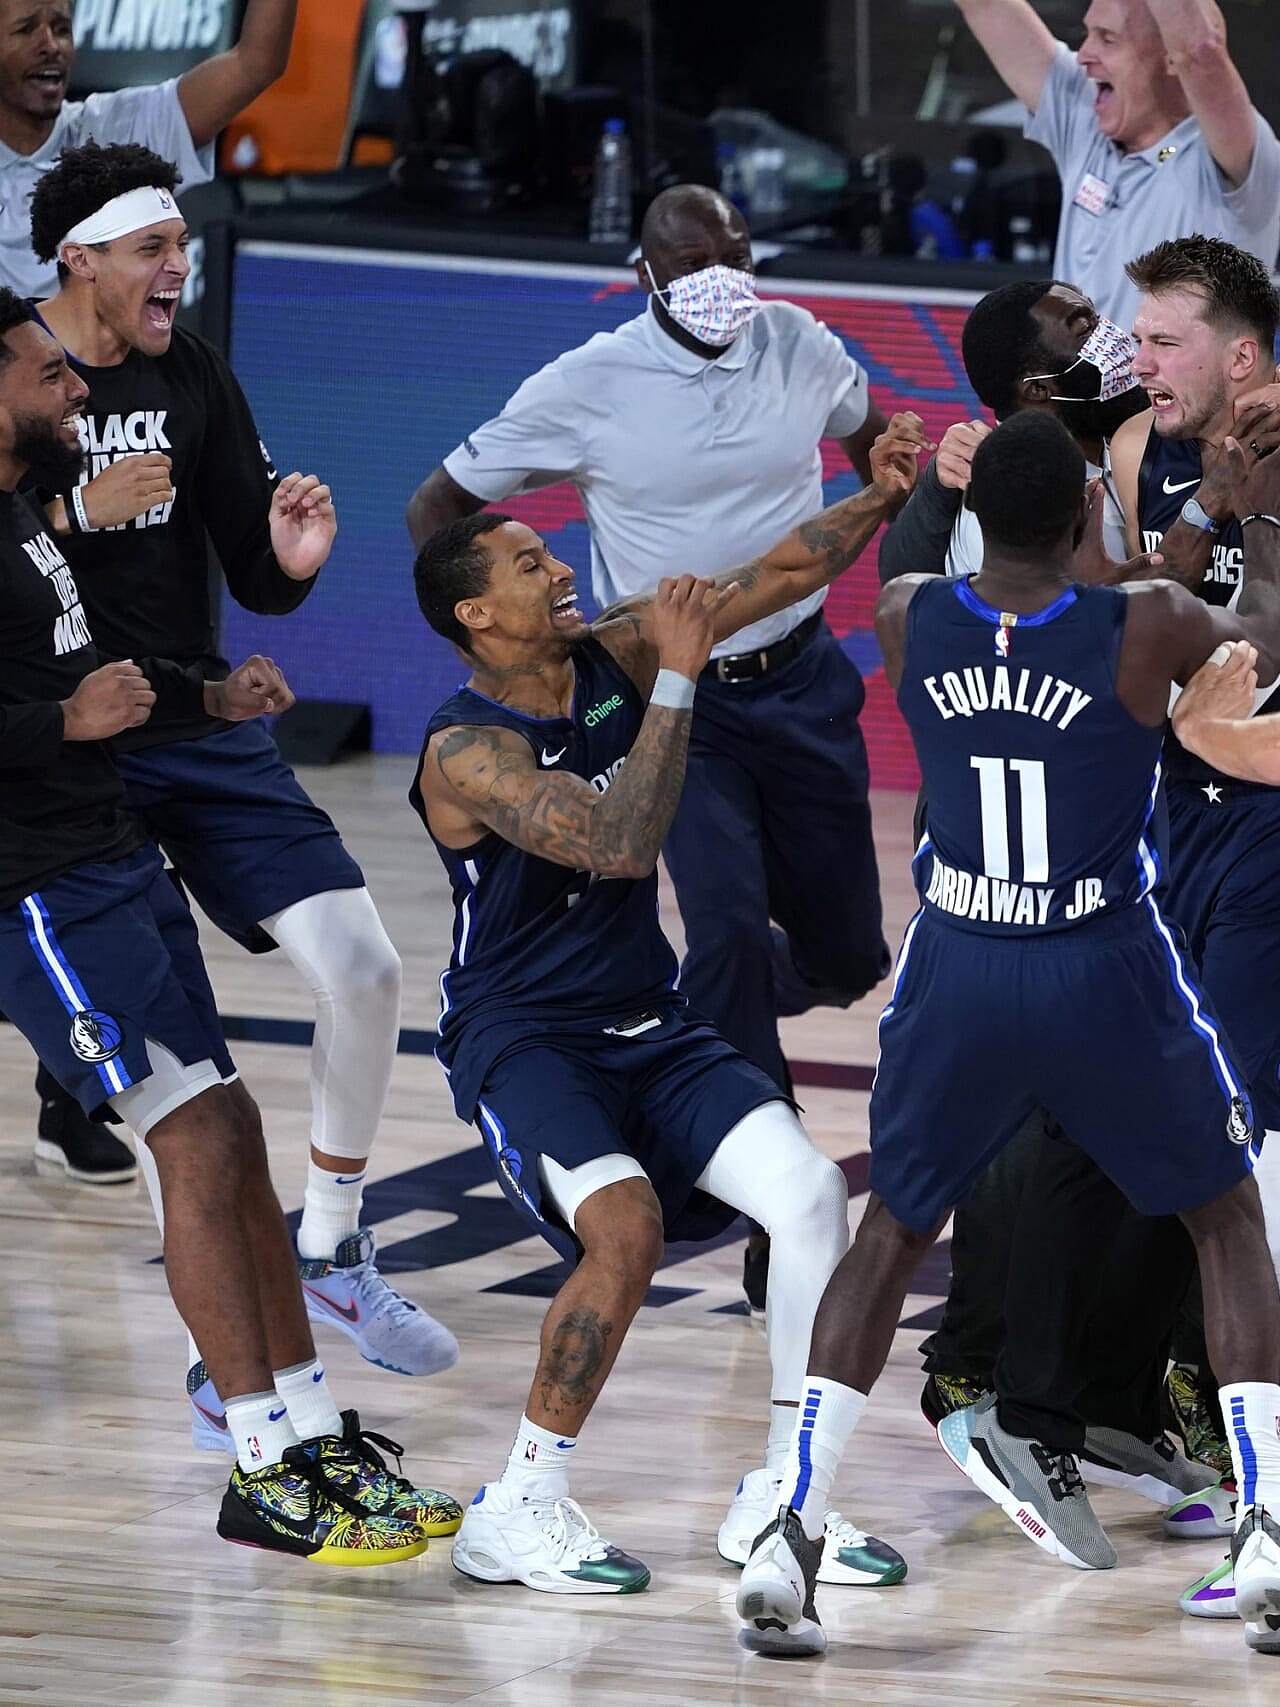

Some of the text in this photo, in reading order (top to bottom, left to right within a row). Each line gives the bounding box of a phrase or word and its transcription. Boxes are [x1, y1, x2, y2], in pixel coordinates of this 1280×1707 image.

[584, 694, 624, 727] chime
[923, 665, 1093, 731] EQUALITY
[970, 755, 1049, 883] 11
[1016, 1508, 1047, 1539] PUMA
